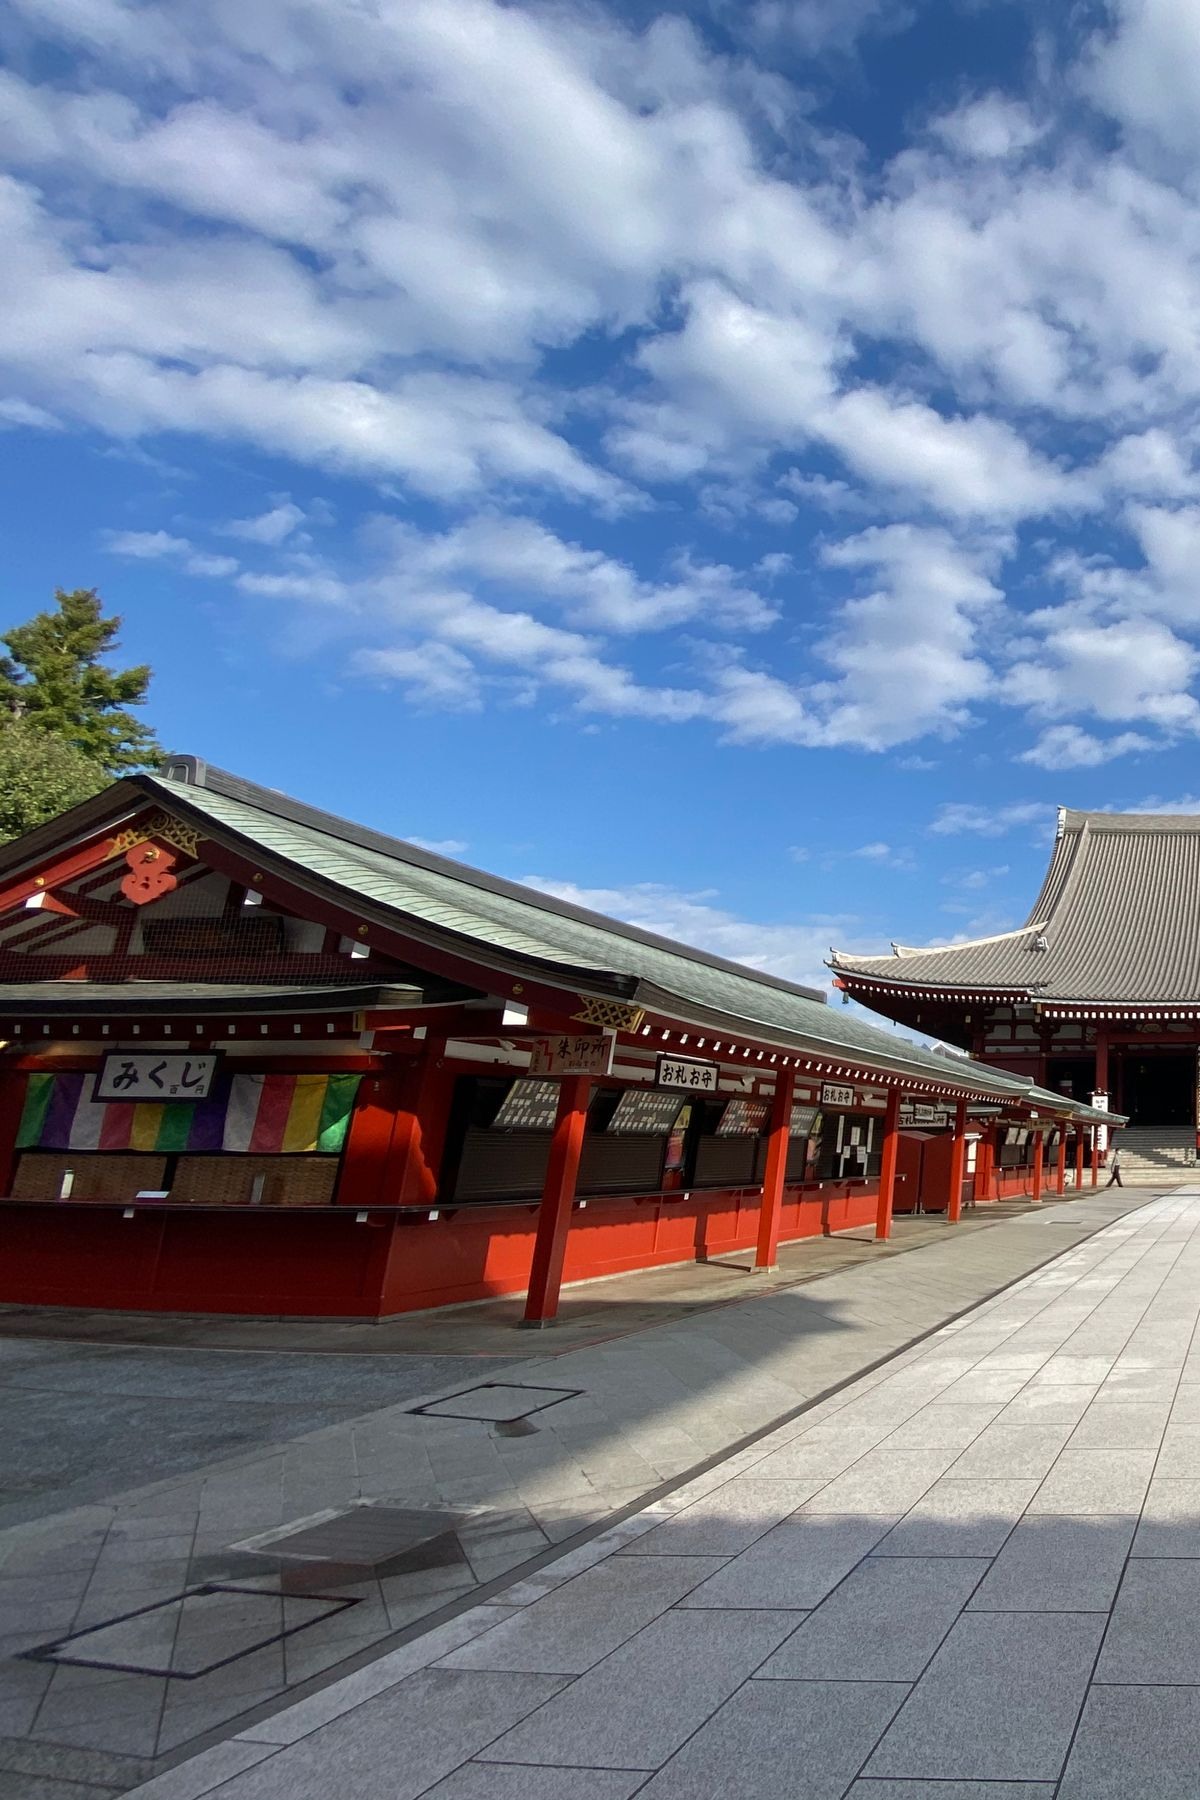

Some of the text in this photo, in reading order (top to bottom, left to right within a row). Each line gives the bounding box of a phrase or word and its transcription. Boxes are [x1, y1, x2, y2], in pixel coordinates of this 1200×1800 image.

[557, 1037, 608, 1060] 朱印所
[113, 1061, 206, 1090] みくじ
[662, 1064, 712, 1089] お札お守
